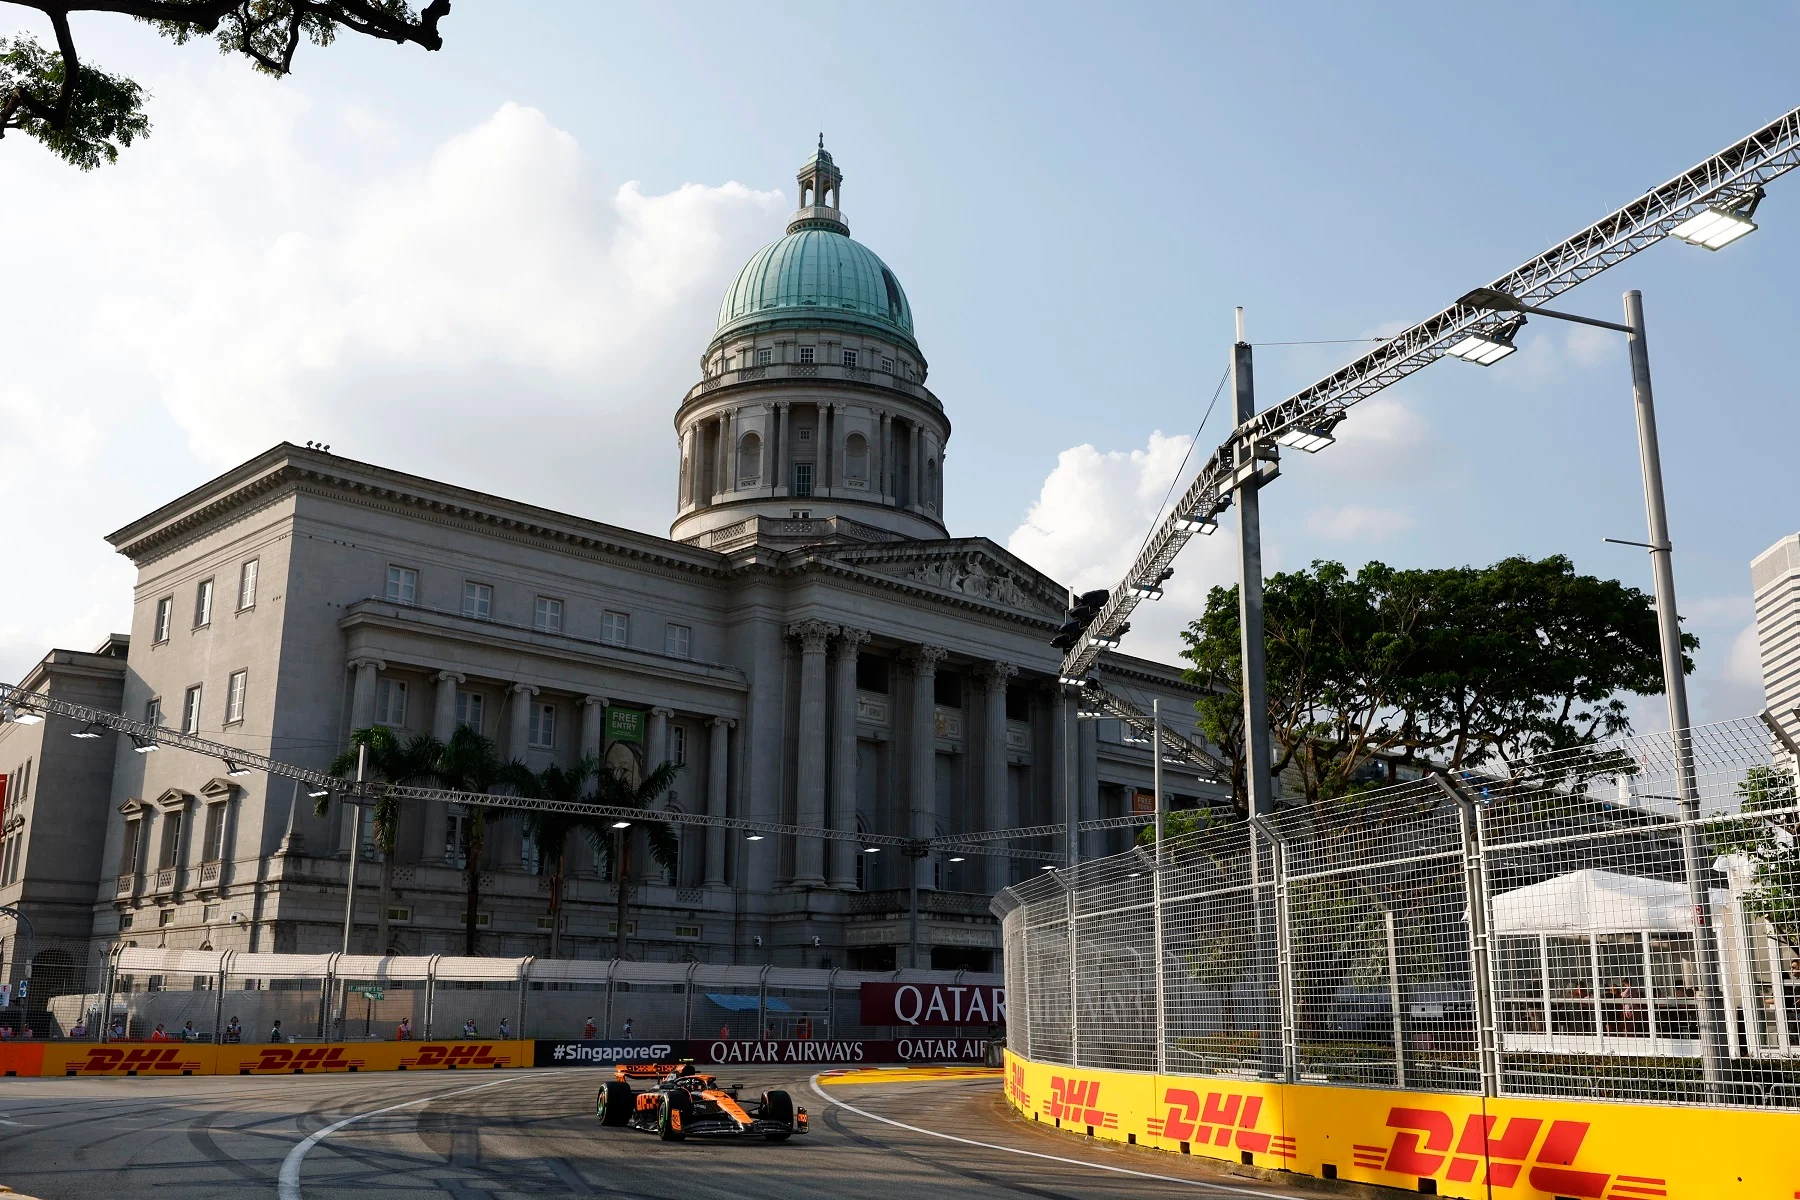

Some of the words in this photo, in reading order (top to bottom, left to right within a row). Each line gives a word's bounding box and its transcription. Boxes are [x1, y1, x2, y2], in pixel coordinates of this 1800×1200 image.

[612, 711, 638, 723] FREE
[612, 721, 637, 731] ENTRY
[1138, 796, 1152, 804] FREE
[894, 985, 1006, 1025] QATAR
[83, 1048, 185, 1071] DHL
[256, 1047, 350, 1070] DHL
[415, 1045, 498, 1066] DHL
[553, 1043, 671, 1062] #SingaporeGP
[710, 1041, 779, 1064] QATAR
[784, 1041, 863, 1062] AIRWAYS
[897, 1039, 958, 1060] QATAR
[1050, 1076, 1105, 1127] DHL
[1163, 1088, 1273, 1155] DHL
[1384, 1106, 1612, 1198] DHL
